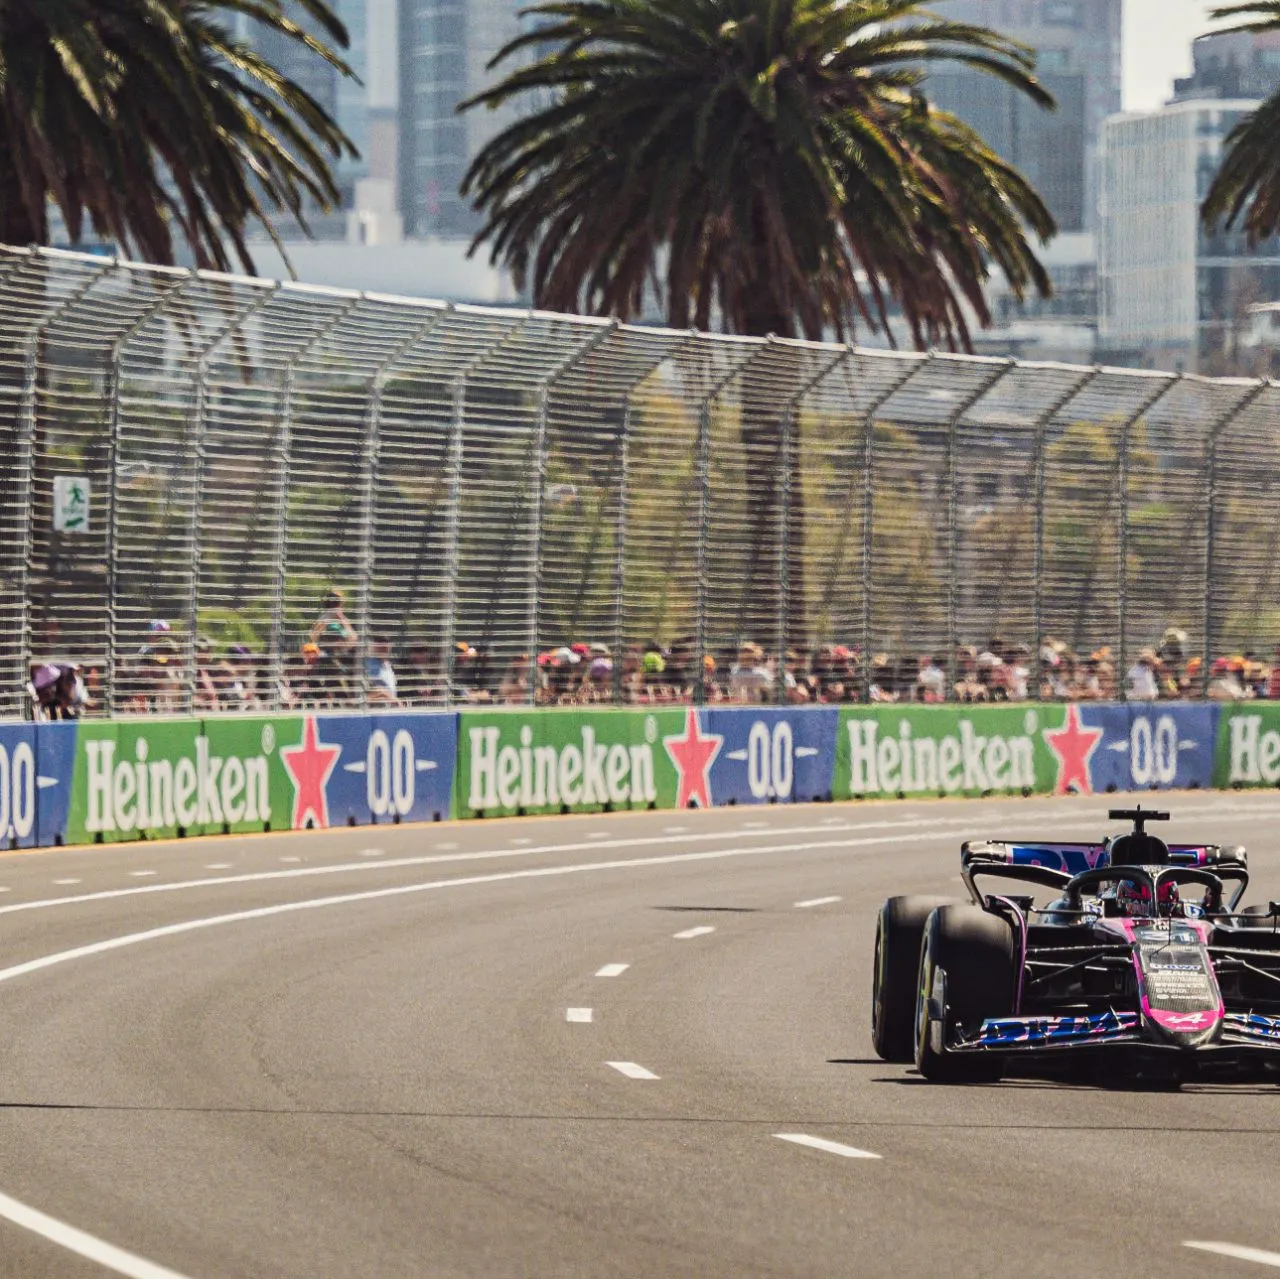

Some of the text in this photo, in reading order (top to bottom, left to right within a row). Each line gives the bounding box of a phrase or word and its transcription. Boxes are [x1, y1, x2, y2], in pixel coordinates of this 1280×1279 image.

[85, 737, 272, 832] Heineken
[469, 725, 656, 810] Heineken
[849, 715, 1034, 793] Heineken
